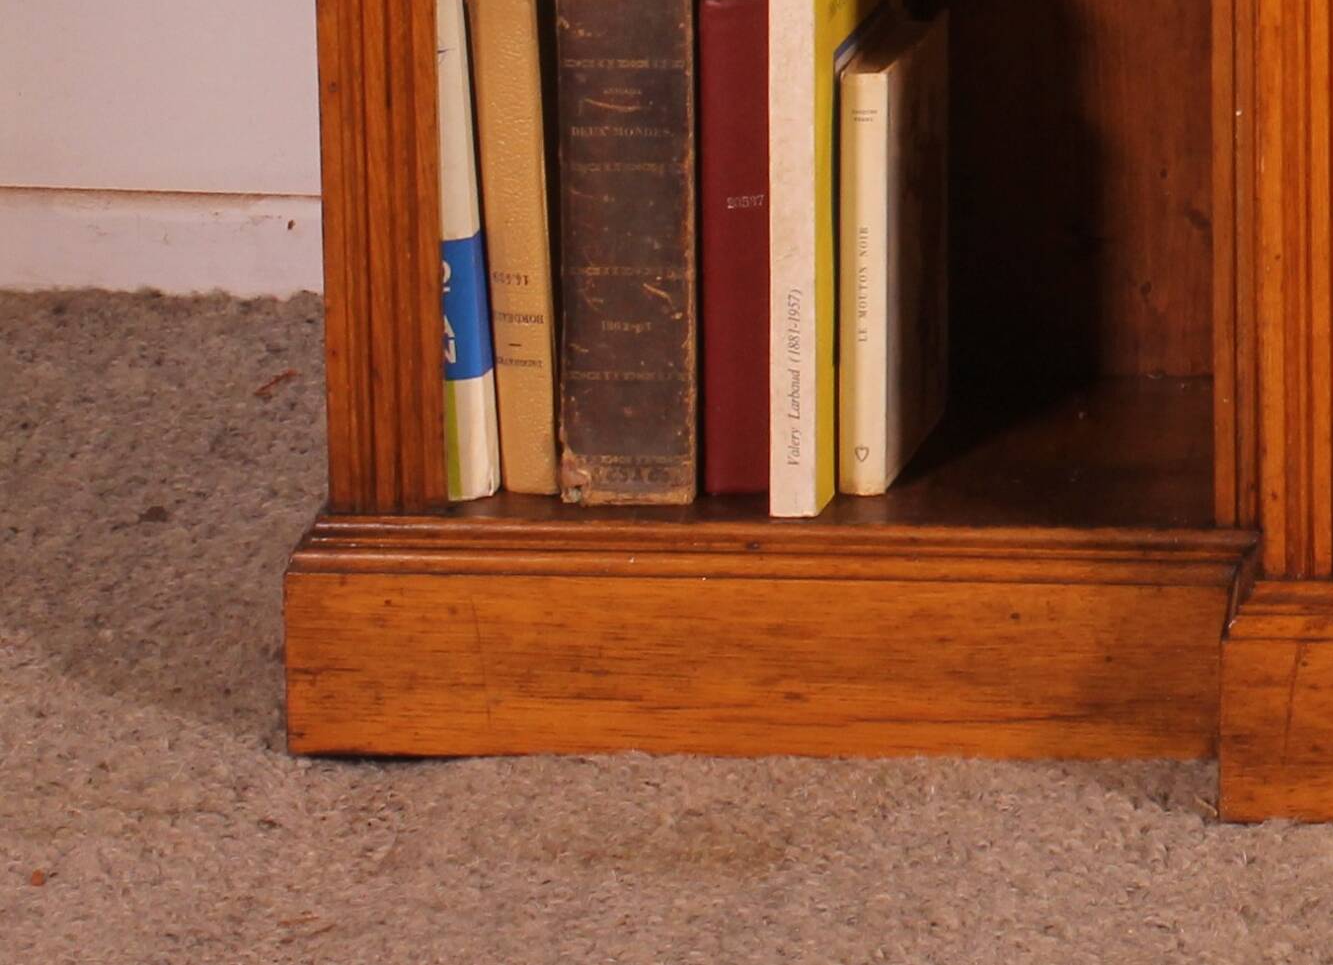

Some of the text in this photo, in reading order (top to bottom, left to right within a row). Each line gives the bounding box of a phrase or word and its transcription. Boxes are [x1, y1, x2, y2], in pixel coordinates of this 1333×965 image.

[857, 226, 869, 257] NOIR
[857, 266, 869, 319] MOUTON
[786, 288, 803, 466] Valery Larbaud (1881-1957)
